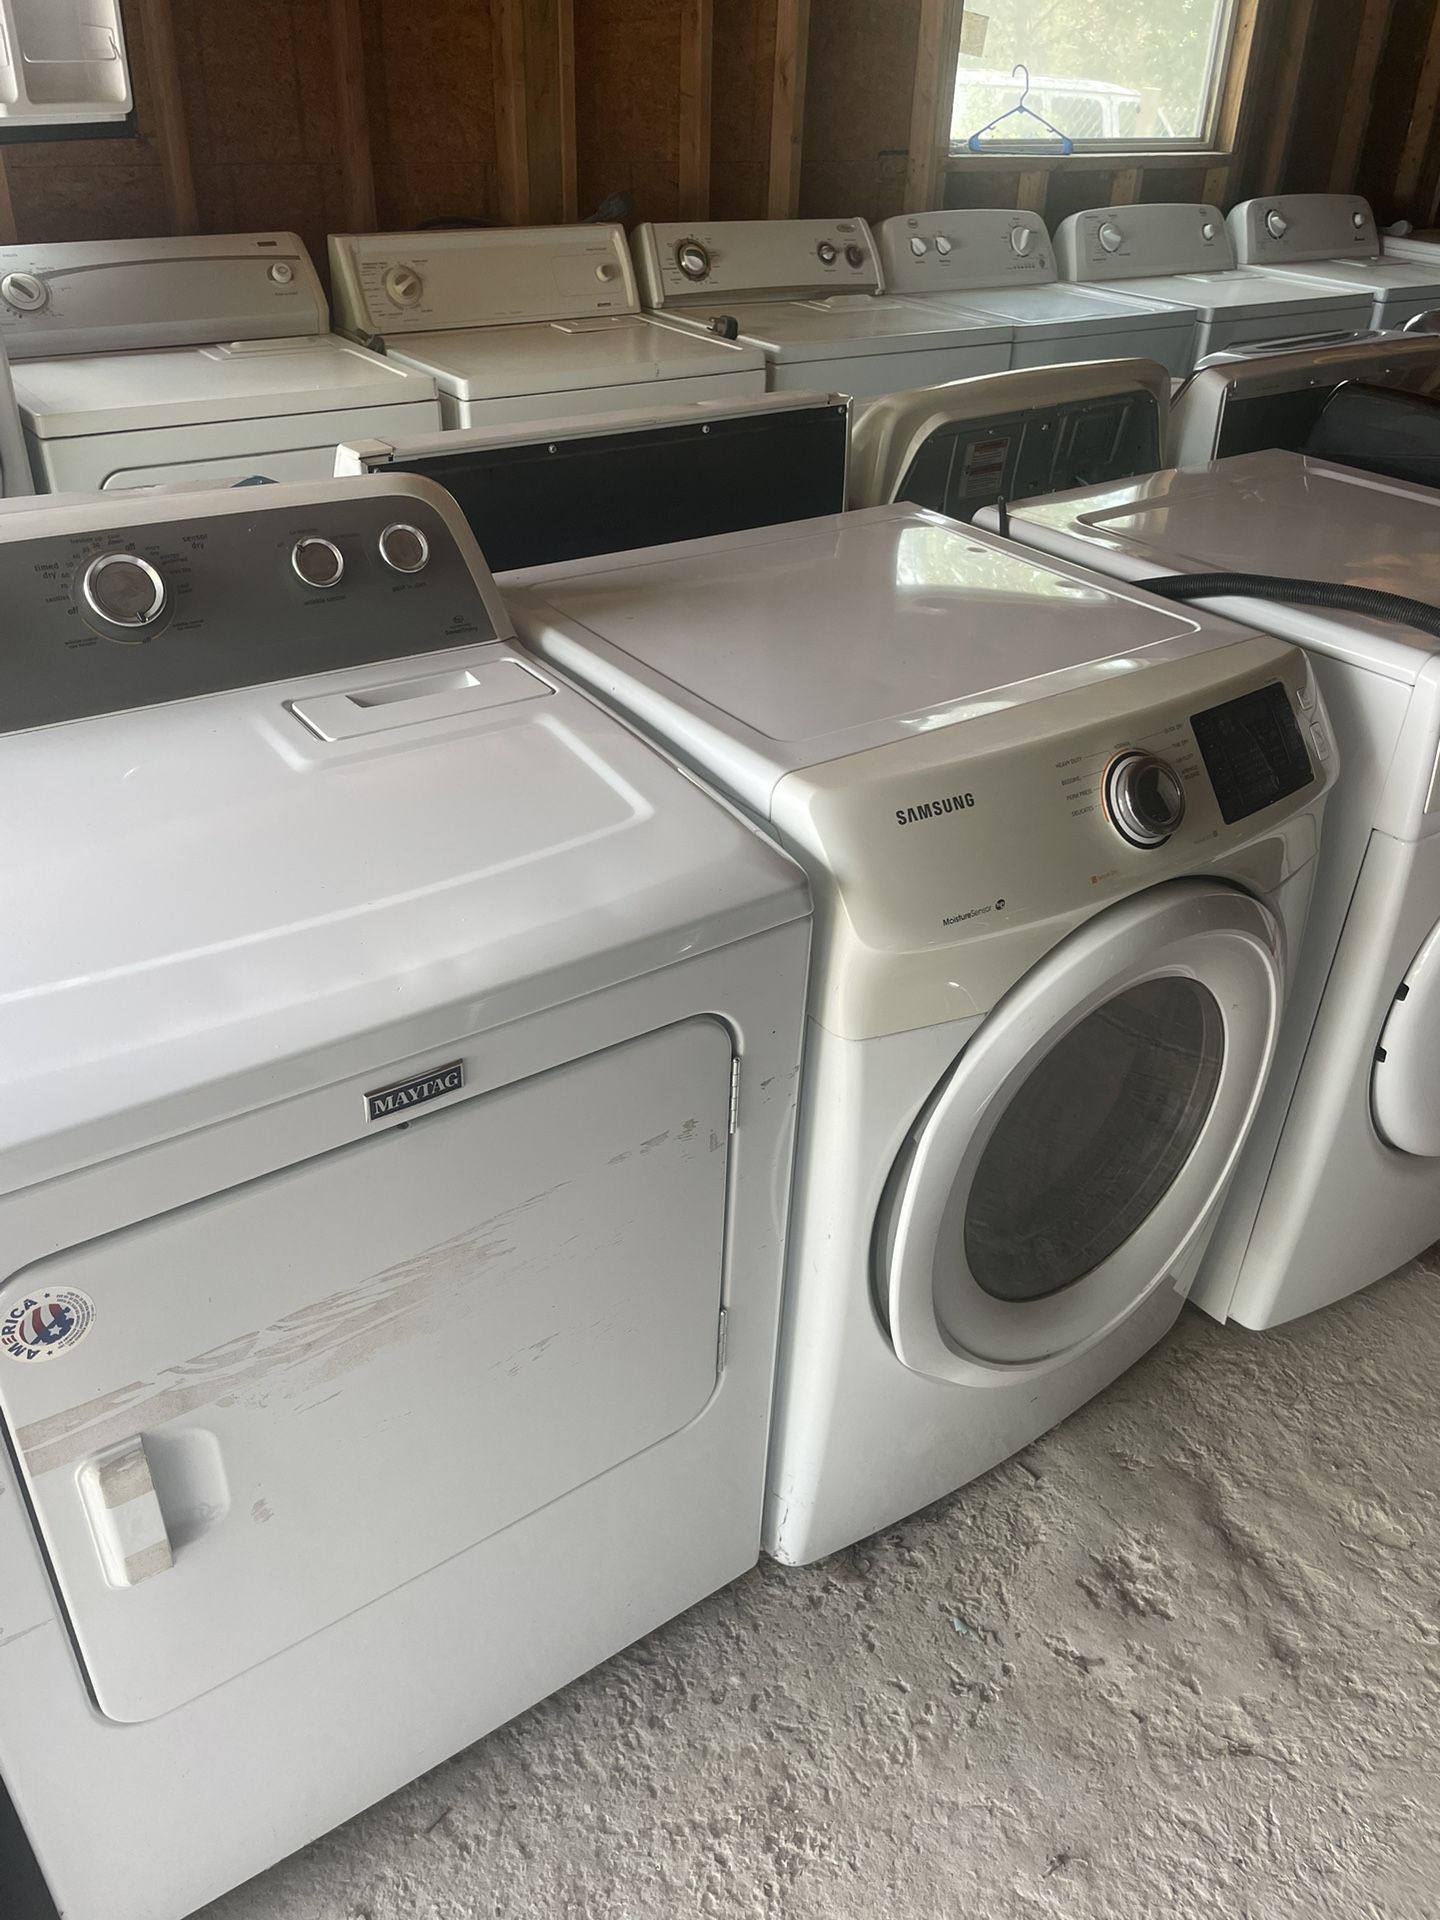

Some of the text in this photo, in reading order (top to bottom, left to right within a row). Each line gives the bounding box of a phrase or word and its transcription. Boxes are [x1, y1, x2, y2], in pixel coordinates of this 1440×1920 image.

[182, 533, 208, 542] sensor
[125, 542, 136, 551] off
[34, 562, 59, 572] timed
[42, 571, 57, 580] dry
[67, 606, 79, 615] off
[895, 792, 975, 826] SAMSUNG
[373, 1072, 459, 1115] MAYTAG
[1, 1298, 40, 1360] AMERICA
